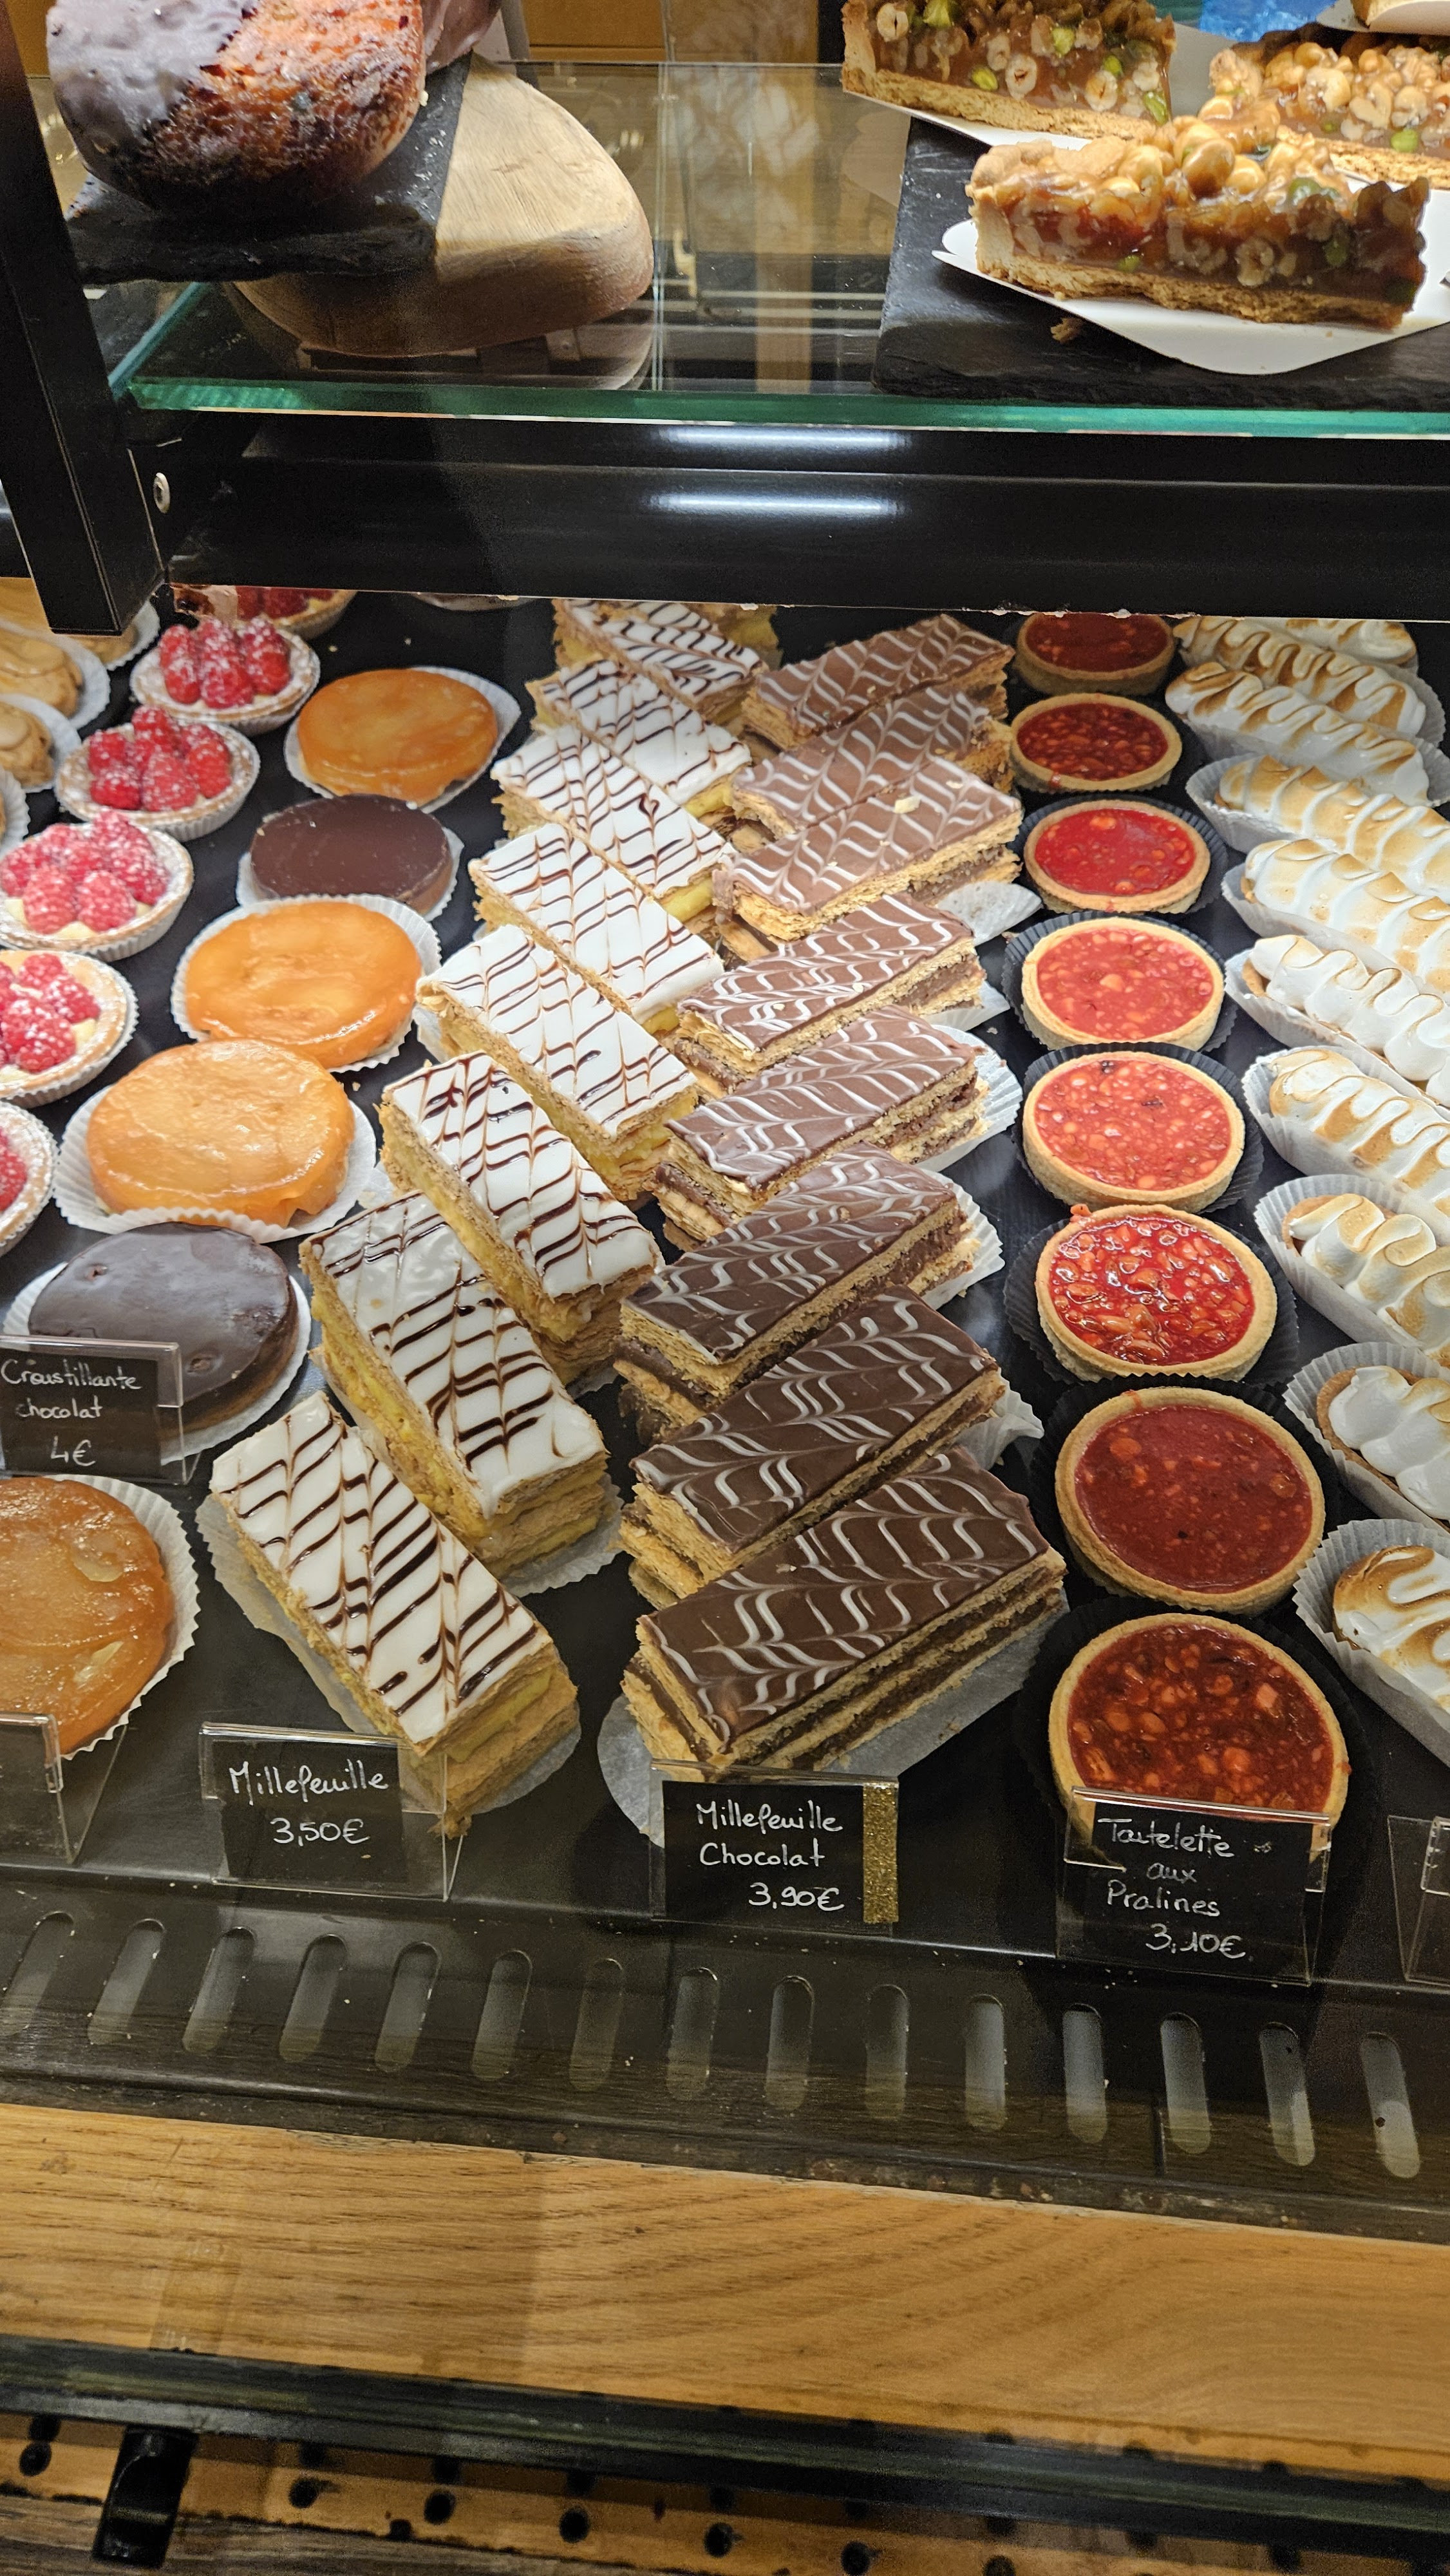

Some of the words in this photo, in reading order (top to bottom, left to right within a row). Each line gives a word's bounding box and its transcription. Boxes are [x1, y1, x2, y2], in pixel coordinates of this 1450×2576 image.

[1, 1358, 142, 1390] Croustillante
[16, 1395, 103, 1419] chocolat
[51, 1435, 96, 1467] 4€
[229, 1758, 389, 1806] Millefeuille
[270, 1817, 370, 1847] 3,50€
[695, 1799, 843, 1835] Millefeuille
[699, 1837, 825, 1867] Chocolat
[1097, 1818, 1235, 1859] Tartelette
[1146, 1862, 1198, 1884] aux
[748, 1882, 845, 1911] 3,90€
[1107, 1879, 1221, 1917] Pralines
